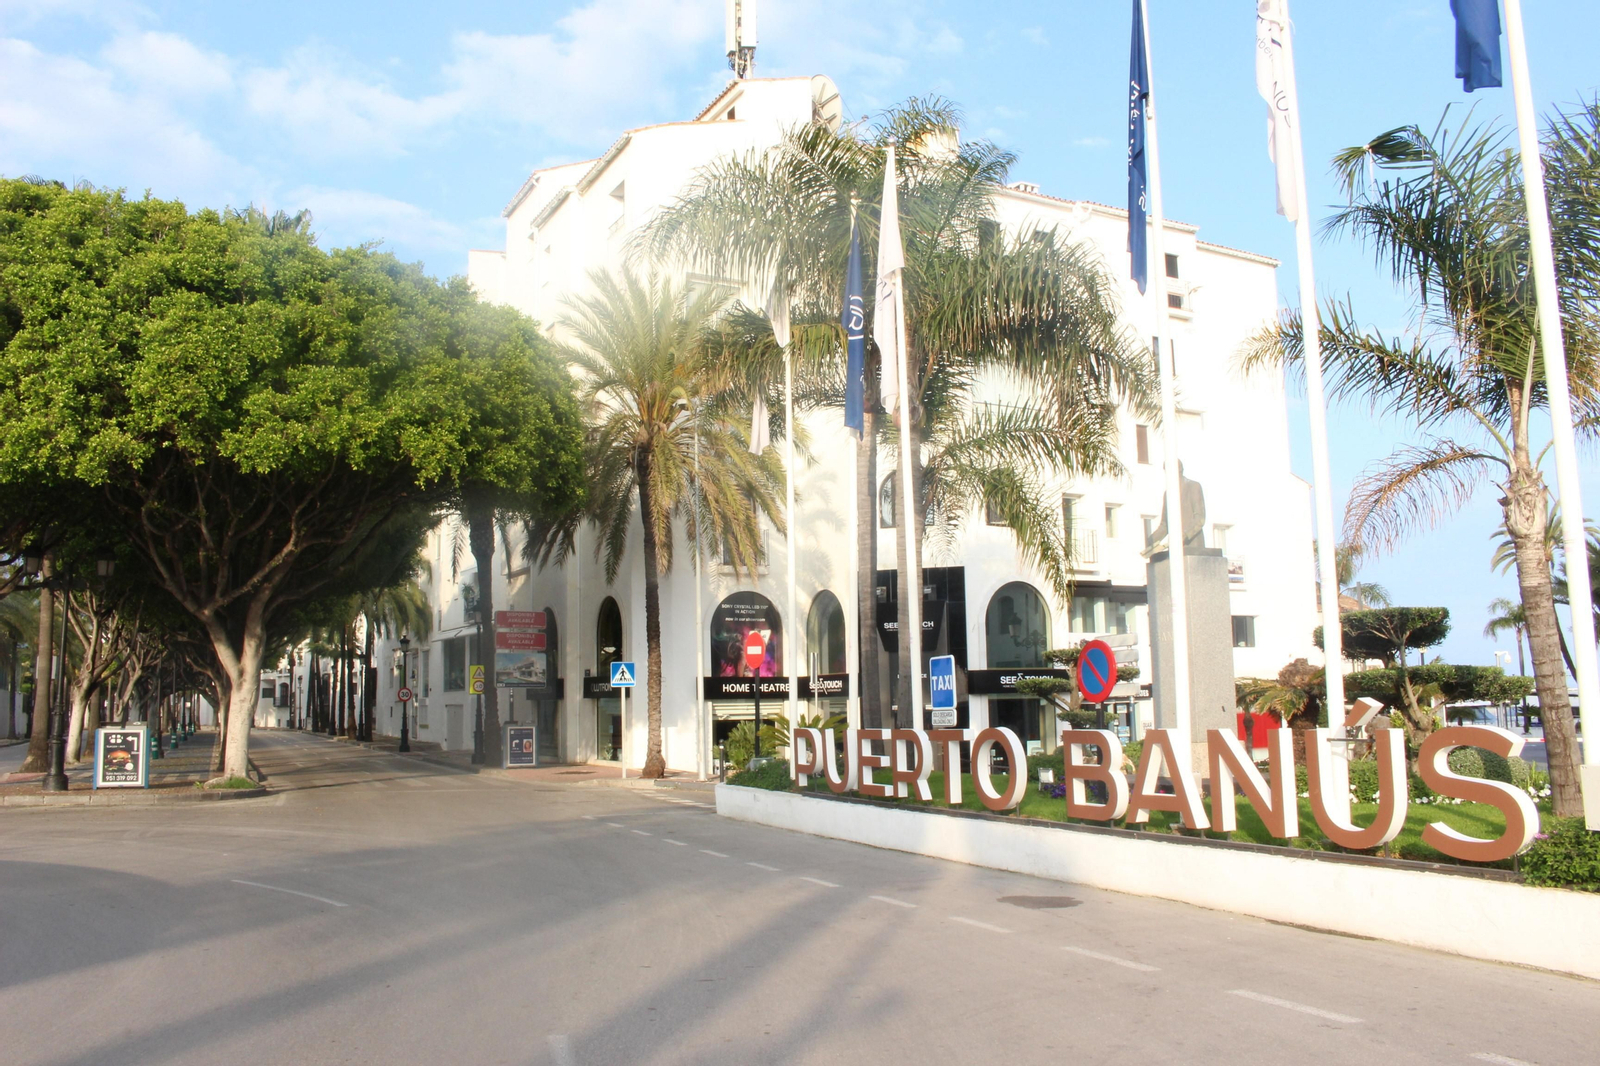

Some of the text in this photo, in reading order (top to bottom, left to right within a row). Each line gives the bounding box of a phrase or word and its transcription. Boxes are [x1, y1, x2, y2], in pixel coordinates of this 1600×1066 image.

[932, 675, 952, 691] TAXI
[1000, 676, 1016, 684] SEE
[722, 684, 790, 692] HOME THEATRE
[794, 696, 1541, 863] PUERTO BANÚS
